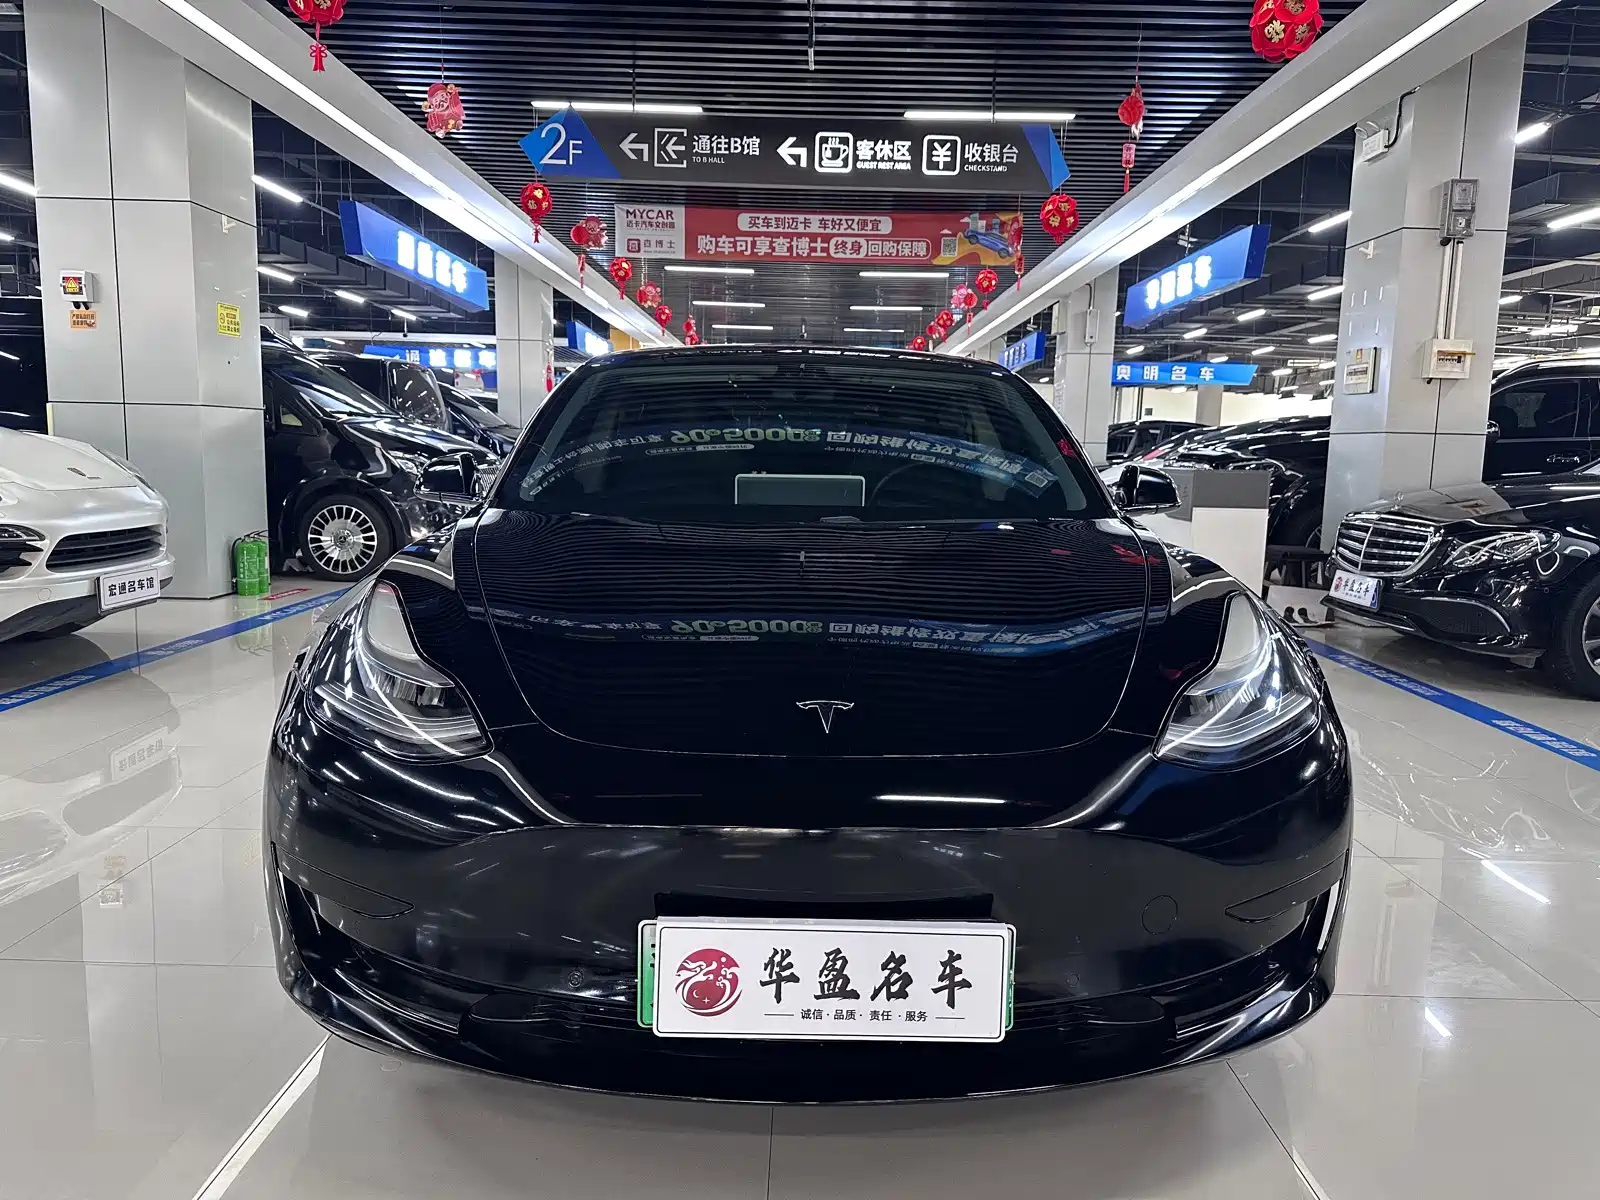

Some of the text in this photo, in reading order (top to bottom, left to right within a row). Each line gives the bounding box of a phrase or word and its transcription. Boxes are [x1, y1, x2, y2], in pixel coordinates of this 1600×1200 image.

[539, 122, 583, 165] 2F
[692, 135, 761, 156] 通往B馆
[856, 139, 912, 161] 客休区
[708, 156, 725, 164] HALL
[964, 142, 1019, 164] 收银台
[856, 161, 911, 171] GUEST REST AREA
[964, 164, 1008, 172] CHECKSTAND
[626, 208, 674, 220] MYCAR
[747, 216, 882, 232] 买车到迈卡 车好又便宜
[1115, 365, 1215, 381] 奥明名车
[108, 576, 155, 598] 宏通名车馆
[759, 946, 973, 1010] 华盈名车
